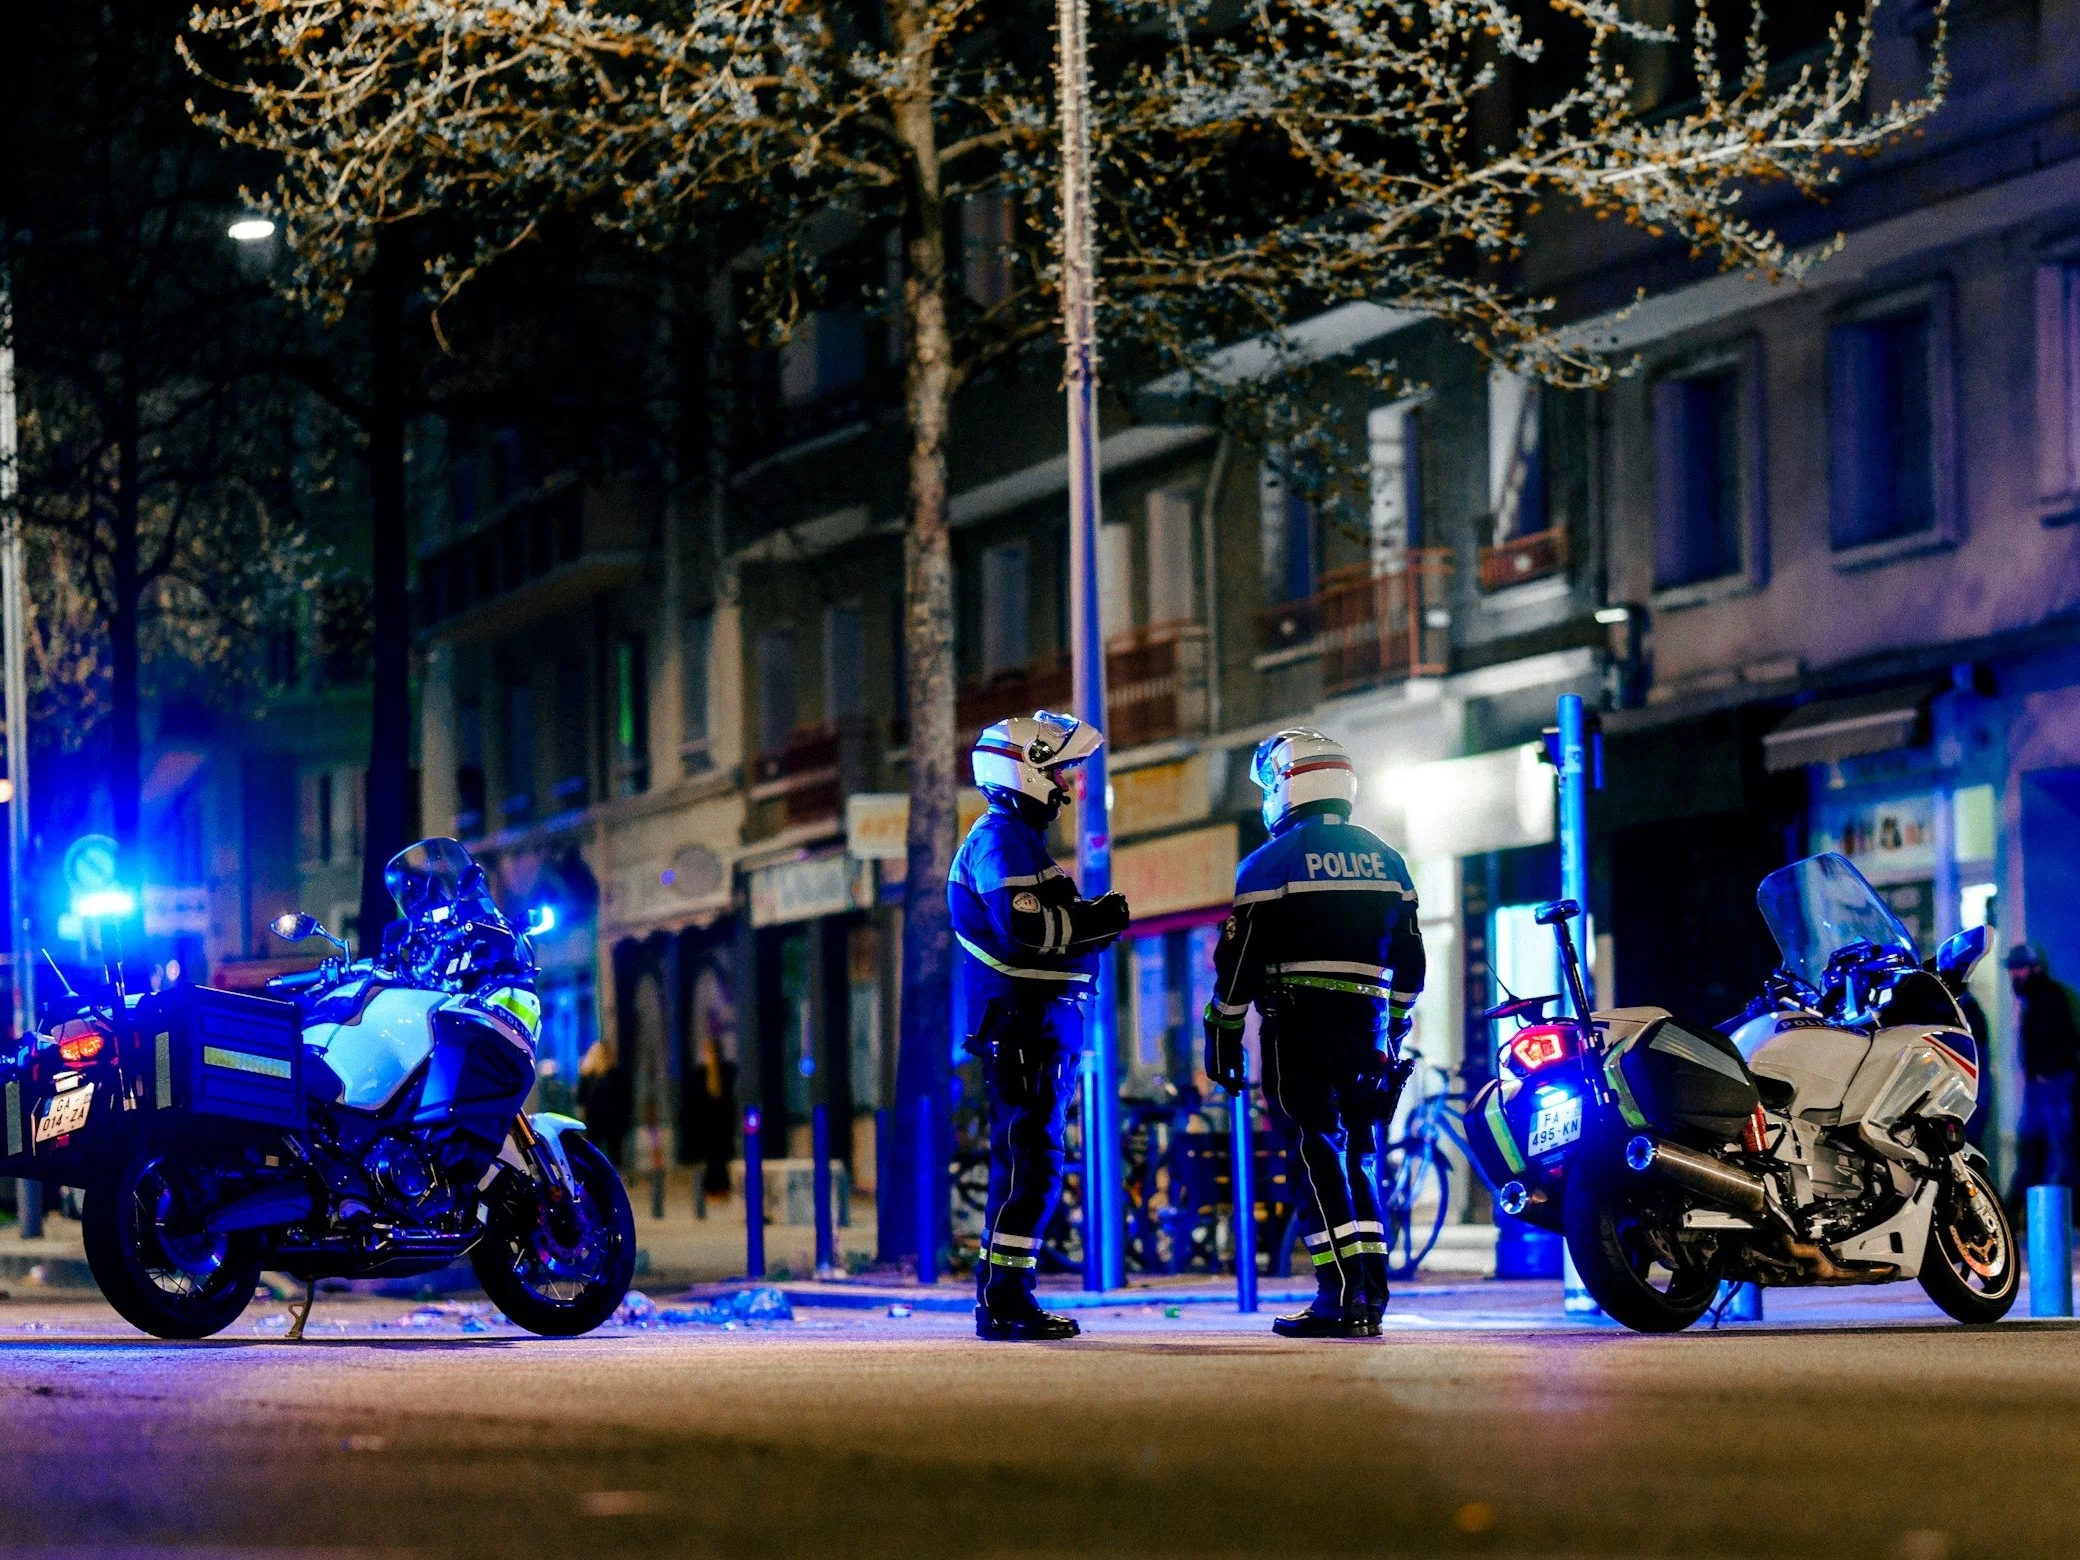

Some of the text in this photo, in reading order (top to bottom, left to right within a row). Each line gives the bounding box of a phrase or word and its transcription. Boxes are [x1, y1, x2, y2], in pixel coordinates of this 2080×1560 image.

[1305, 852, 1387, 879] POLICE
[42, 1106, 85, 1131] 014-ZA
[1532, 1118, 1578, 1146] 495-KN
